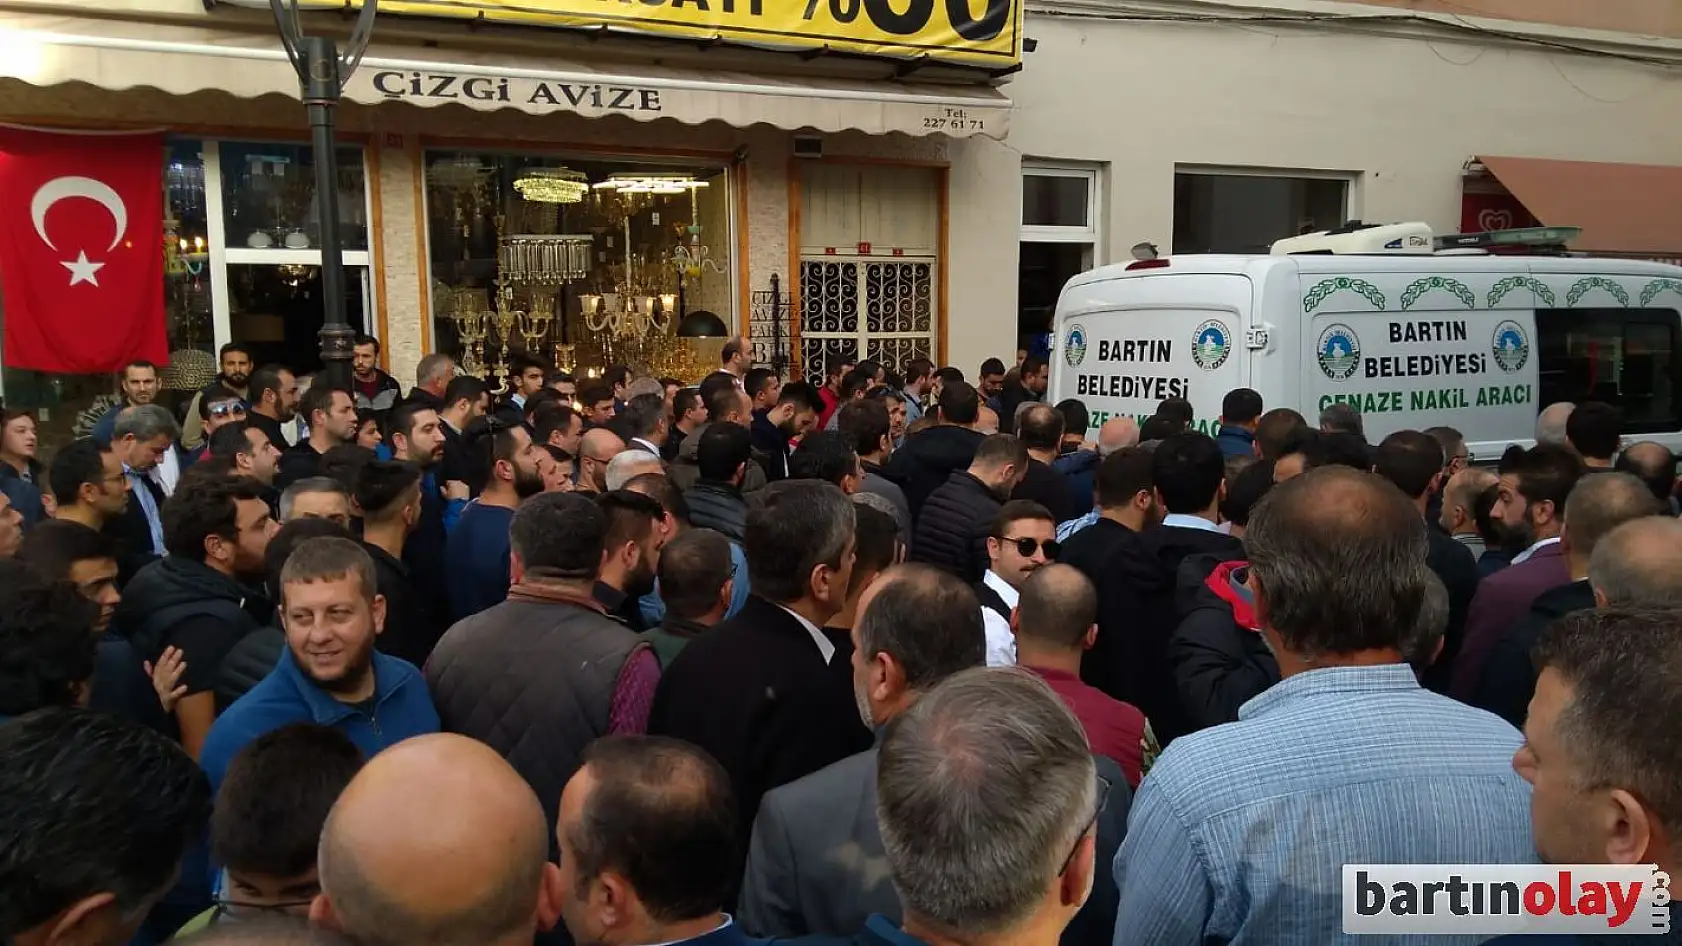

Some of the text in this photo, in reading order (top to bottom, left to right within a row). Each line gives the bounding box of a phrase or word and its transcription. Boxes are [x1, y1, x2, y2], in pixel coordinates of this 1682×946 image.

[923, 117, 984, 130] 227 61 71
[945, 108, 967, 119] Tel:
[1388, 320, 1467, 343] BARTIN
[1098, 340, 1172, 363] BARTIN
[1475, 384, 1531, 406] ARACI
